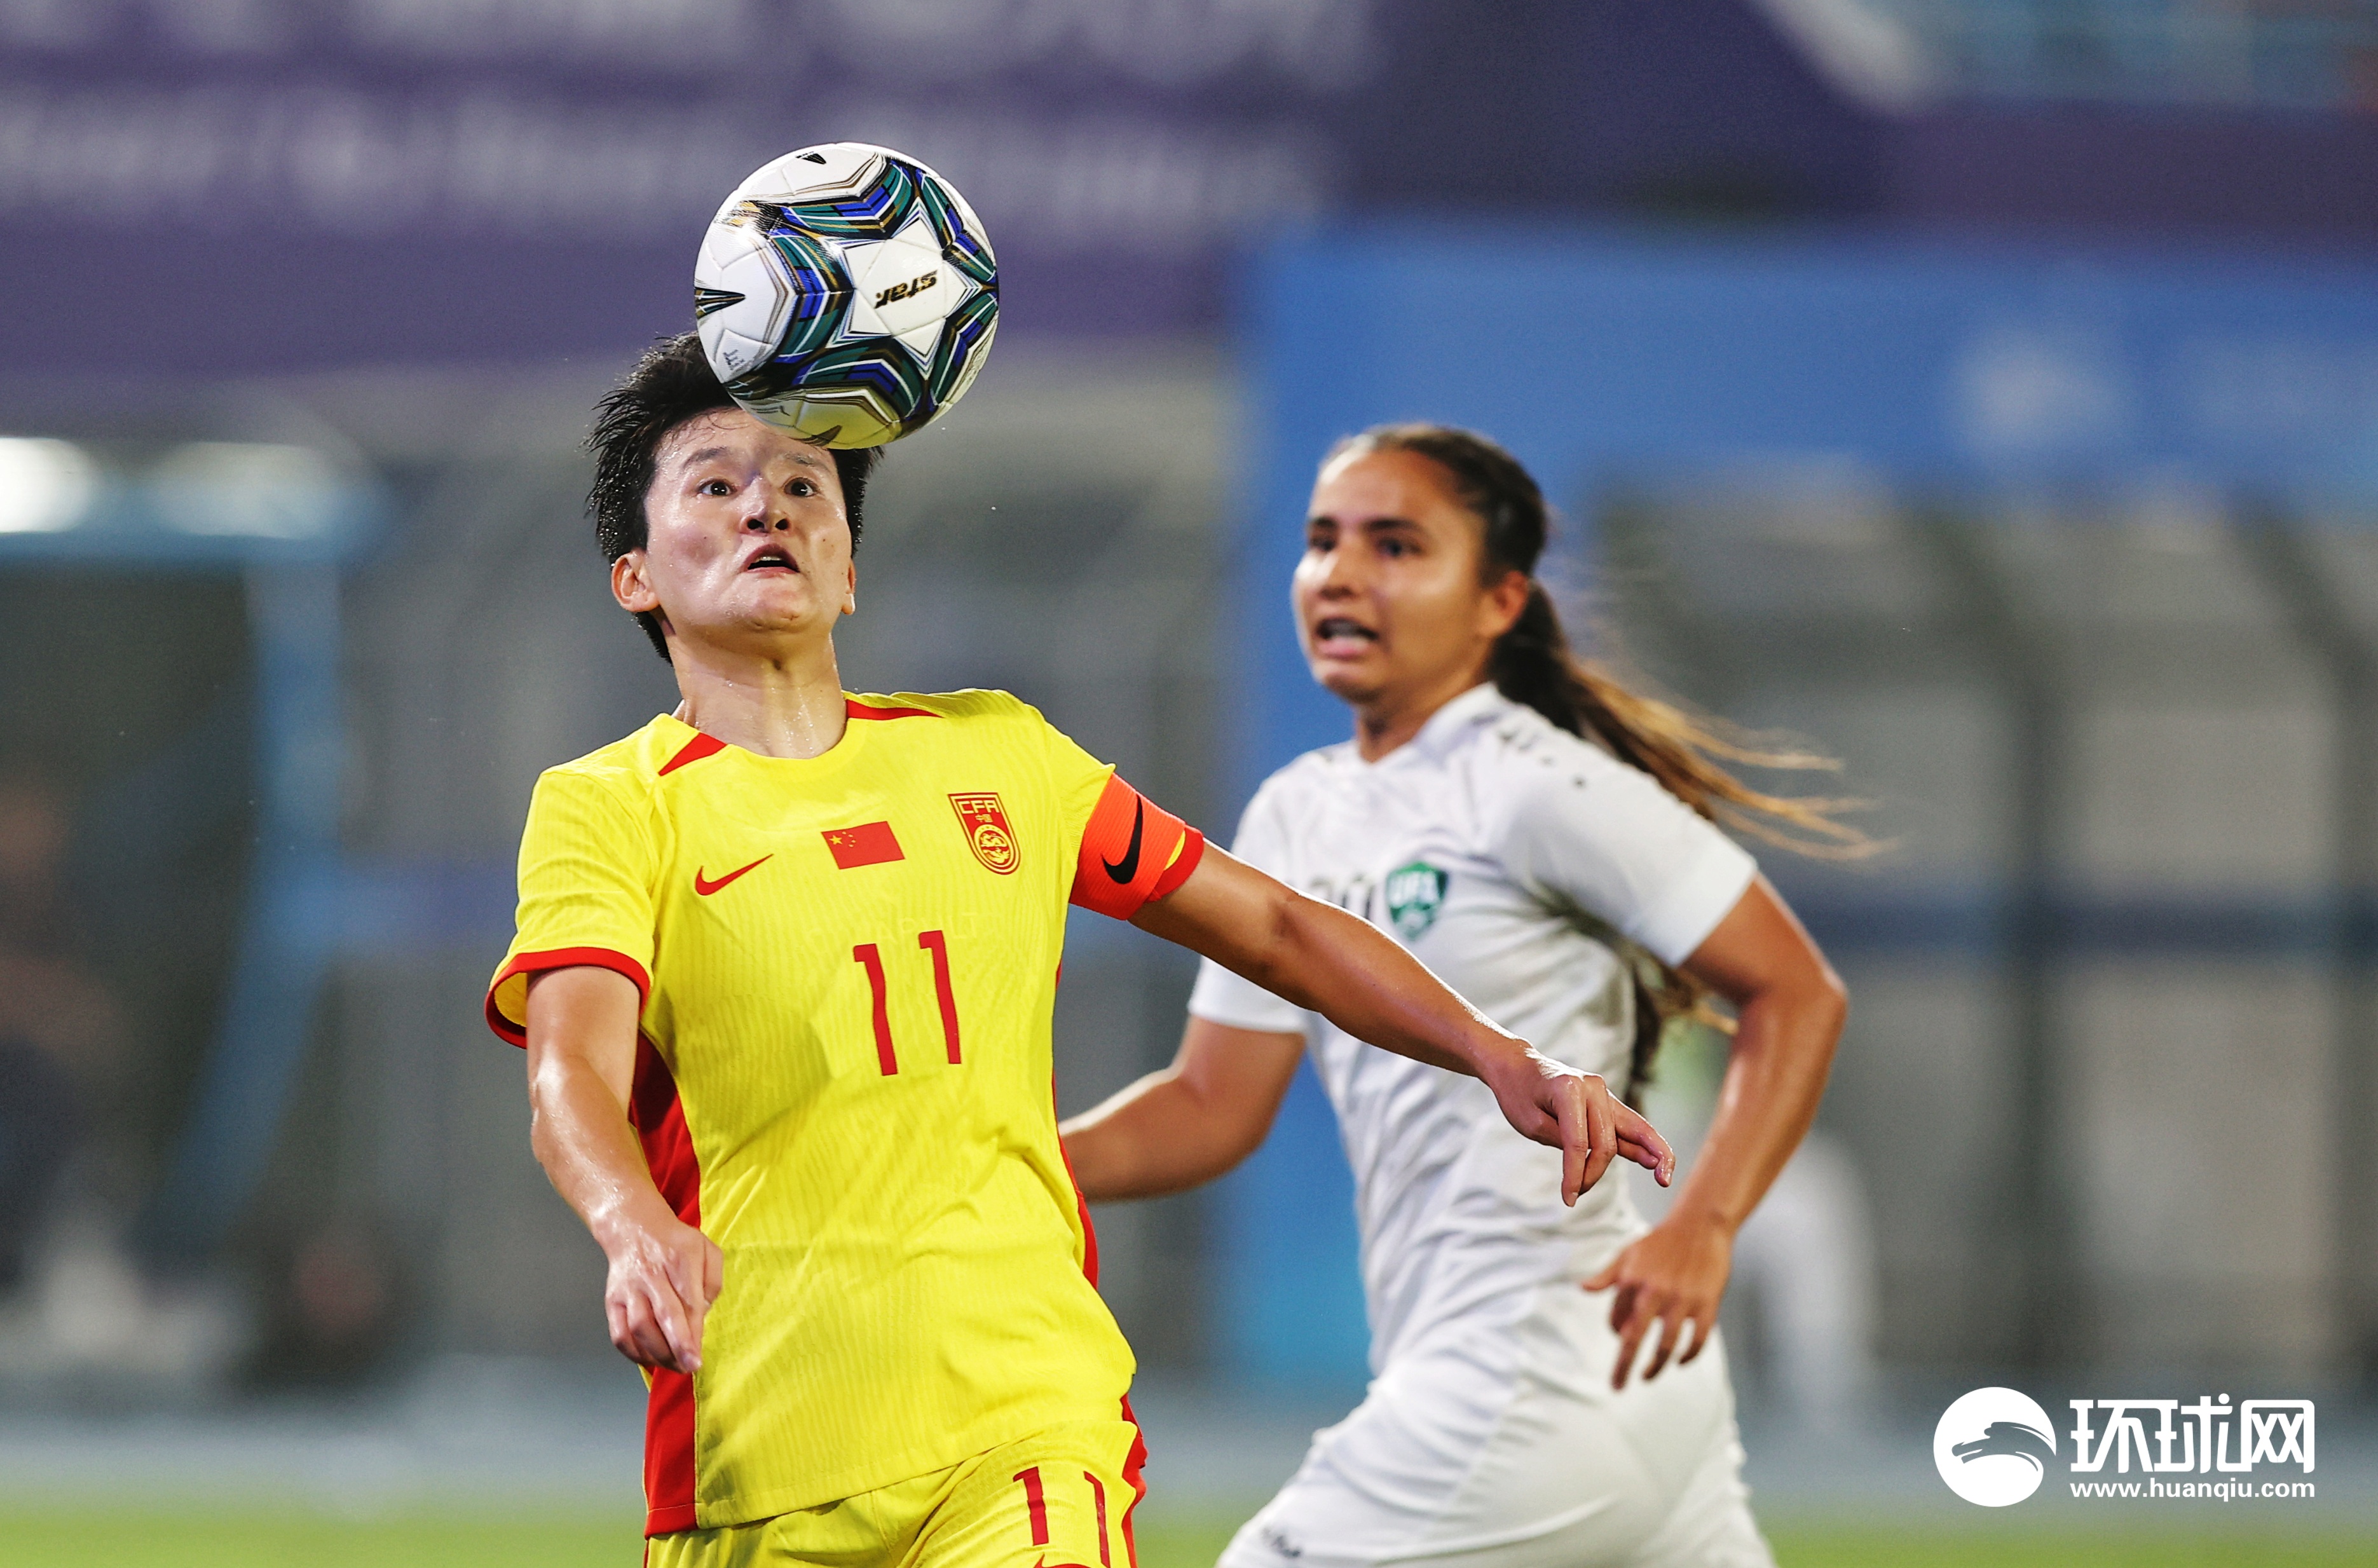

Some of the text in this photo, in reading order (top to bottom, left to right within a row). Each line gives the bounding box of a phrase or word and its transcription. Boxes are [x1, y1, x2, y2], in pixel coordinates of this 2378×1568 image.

[957, 800, 1000, 814] CFA
[974, 814, 994, 823] 中国
[853, 930, 961, 1075] 11
[1013, 1466, 1111, 1568] 11
